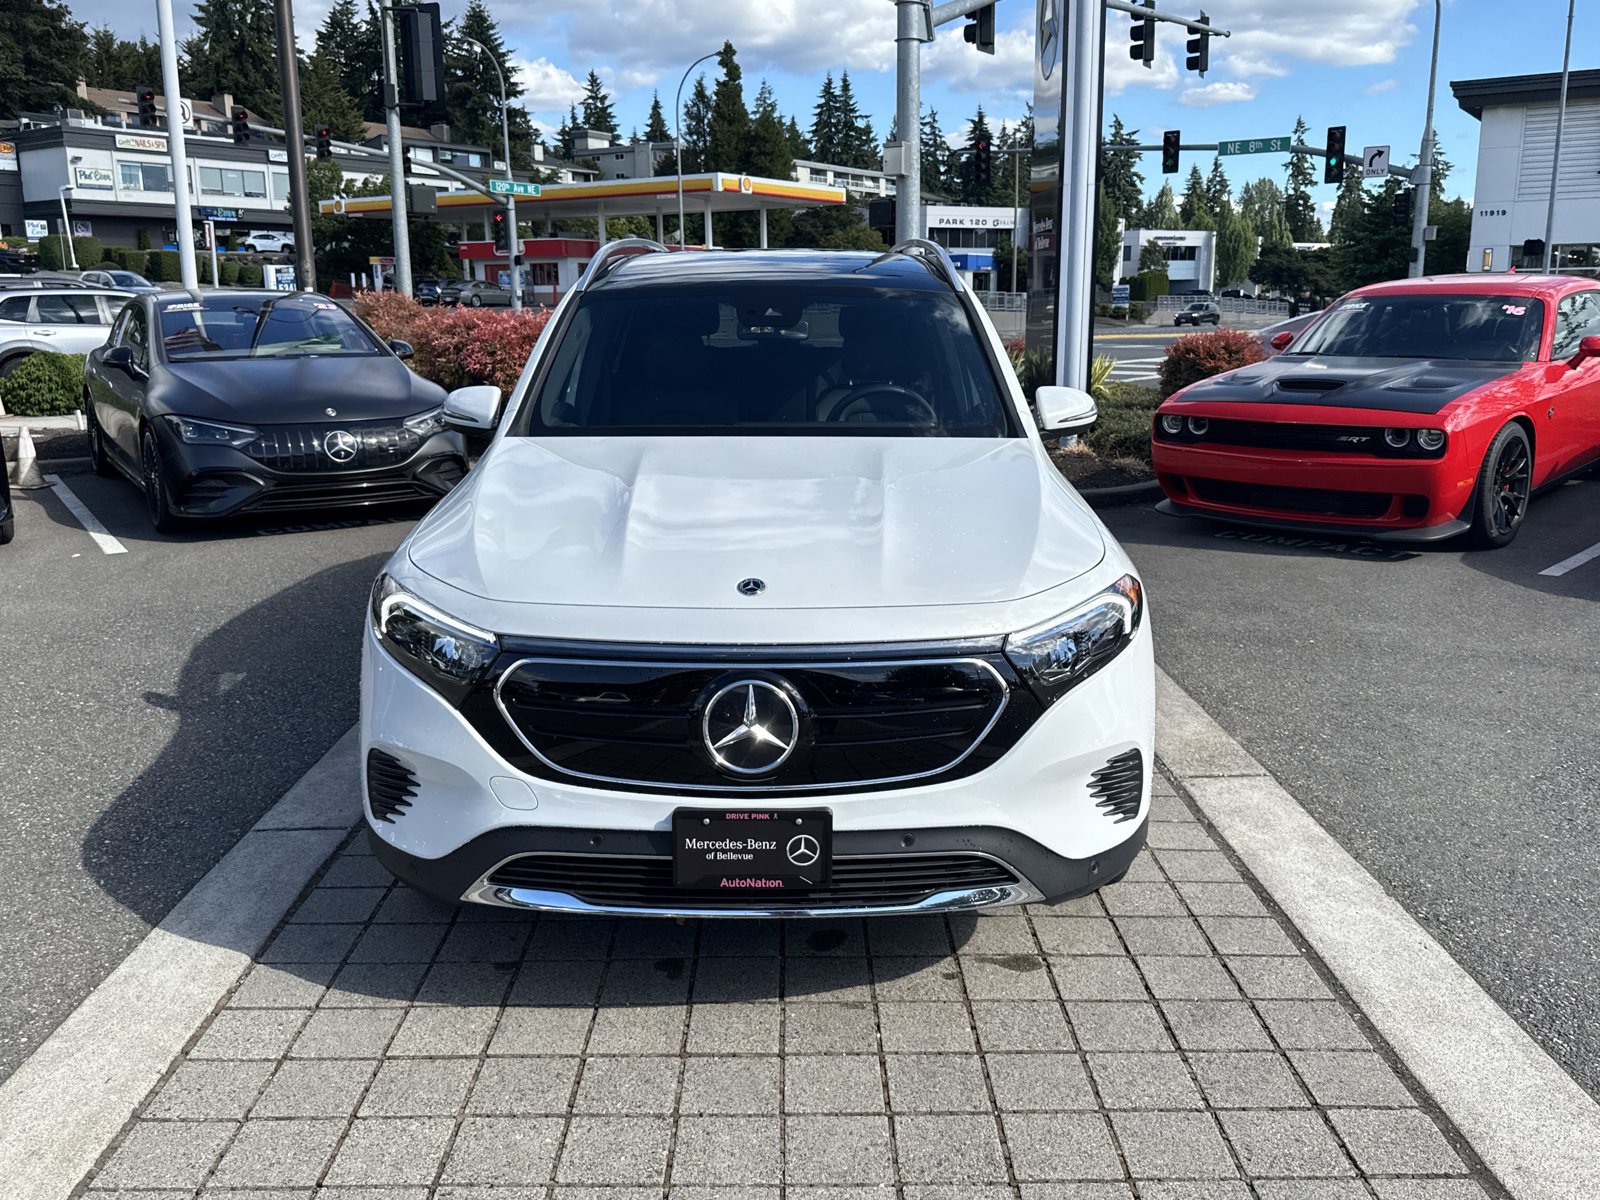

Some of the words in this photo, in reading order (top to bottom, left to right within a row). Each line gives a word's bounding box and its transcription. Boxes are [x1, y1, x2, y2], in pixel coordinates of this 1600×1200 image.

[1227, 142, 1241, 154] NE
[1249, 141, 1263, 152] 8th
[1270, 139, 1281, 151] St
[1366, 168, 1385, 176] ONLY
[496, 182, 510, 192] 120th
[513, 183, 524, 194] Ave
[528, 185, 536, 195] NE
[685, 838, 777, 850] Mercedes-Benz
[706, 851, 714, 860] of
[717, 851, 754, 860] Bellevue
[720, 878, 784, 888] AutoNation
